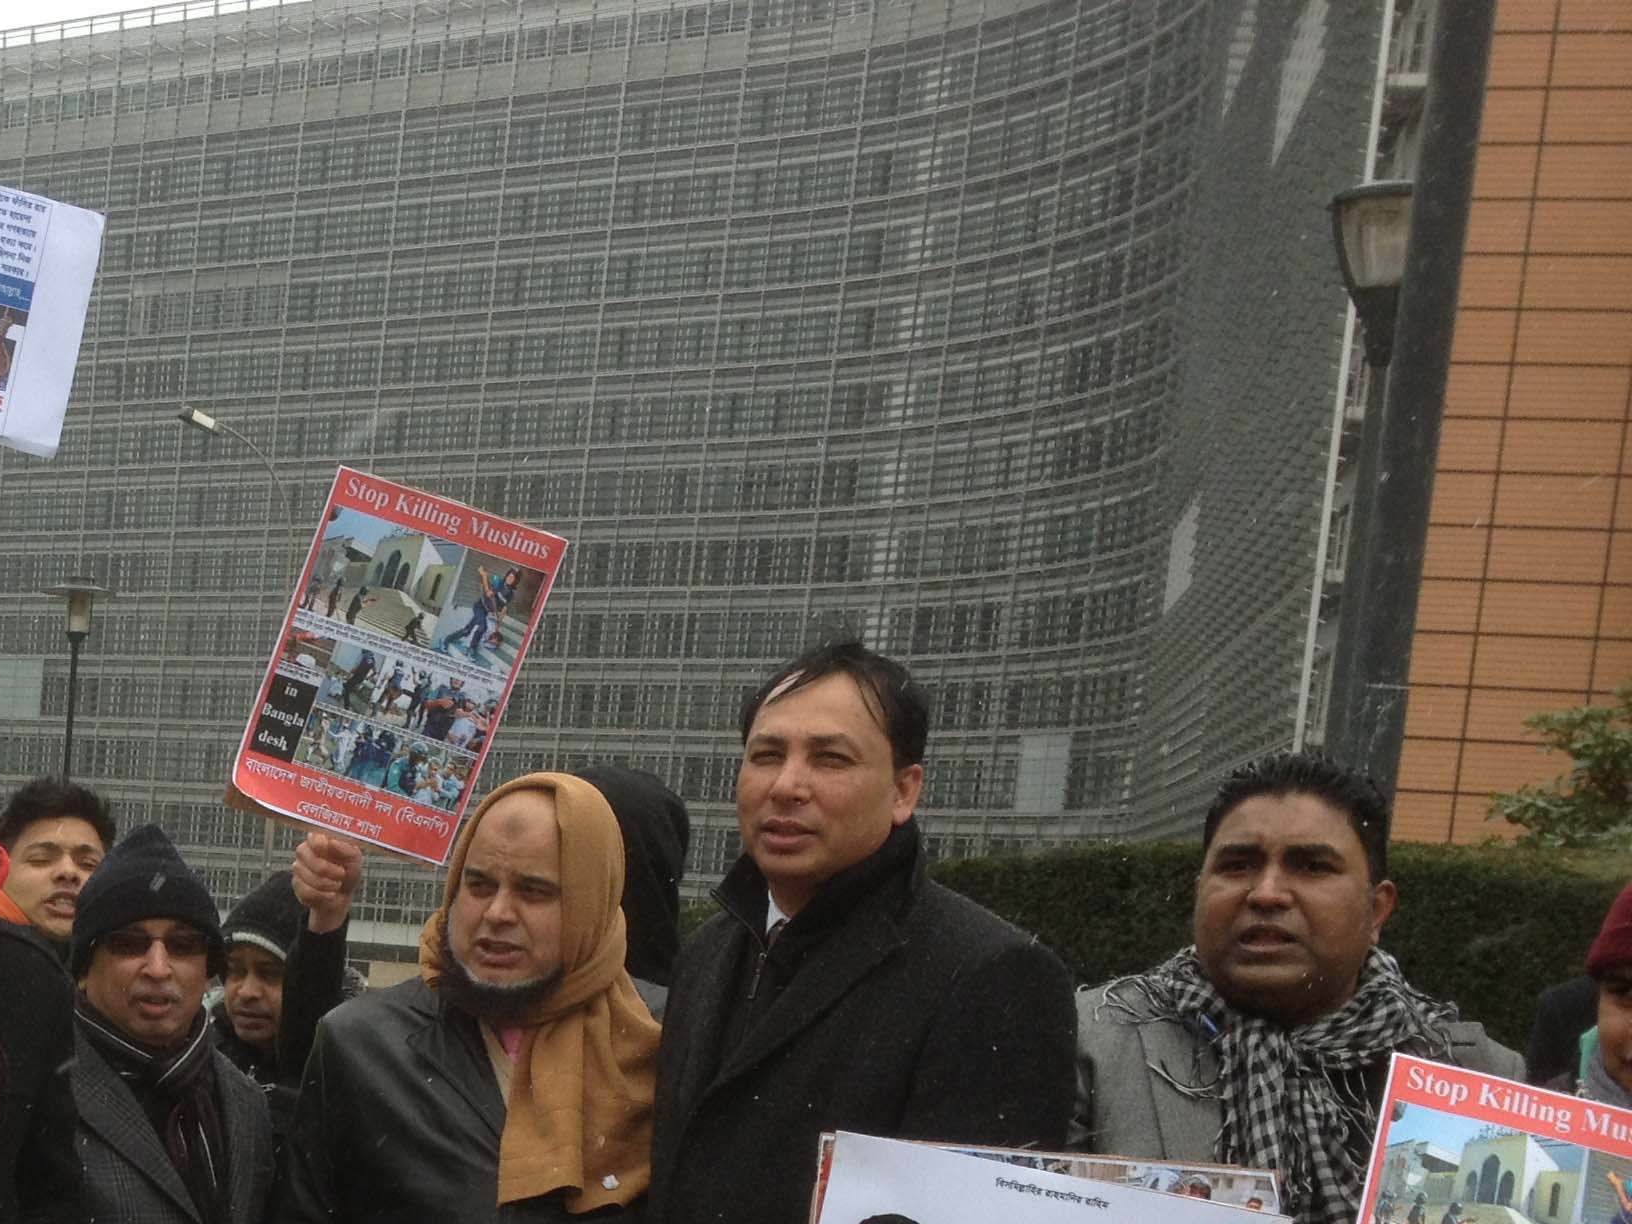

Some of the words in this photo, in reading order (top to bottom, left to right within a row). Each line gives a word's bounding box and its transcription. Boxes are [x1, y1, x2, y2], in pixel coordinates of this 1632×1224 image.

[345, 476, 390, 511] Stop
[394, 492, 462, 535] Killing
[466, 516, 551, 560] Muslims
[284, 682, 298, 697] in
[262, 702, 305, 727] Bangla
[258, 729, 288, 751] desh
[245, 757, 296, 785] বাংলাদেশ
[374, 801, 394, 816] দল
[1406, 1065, 1468, 1106] Stop
[1478, 1082, 1571, 1134] Killing
